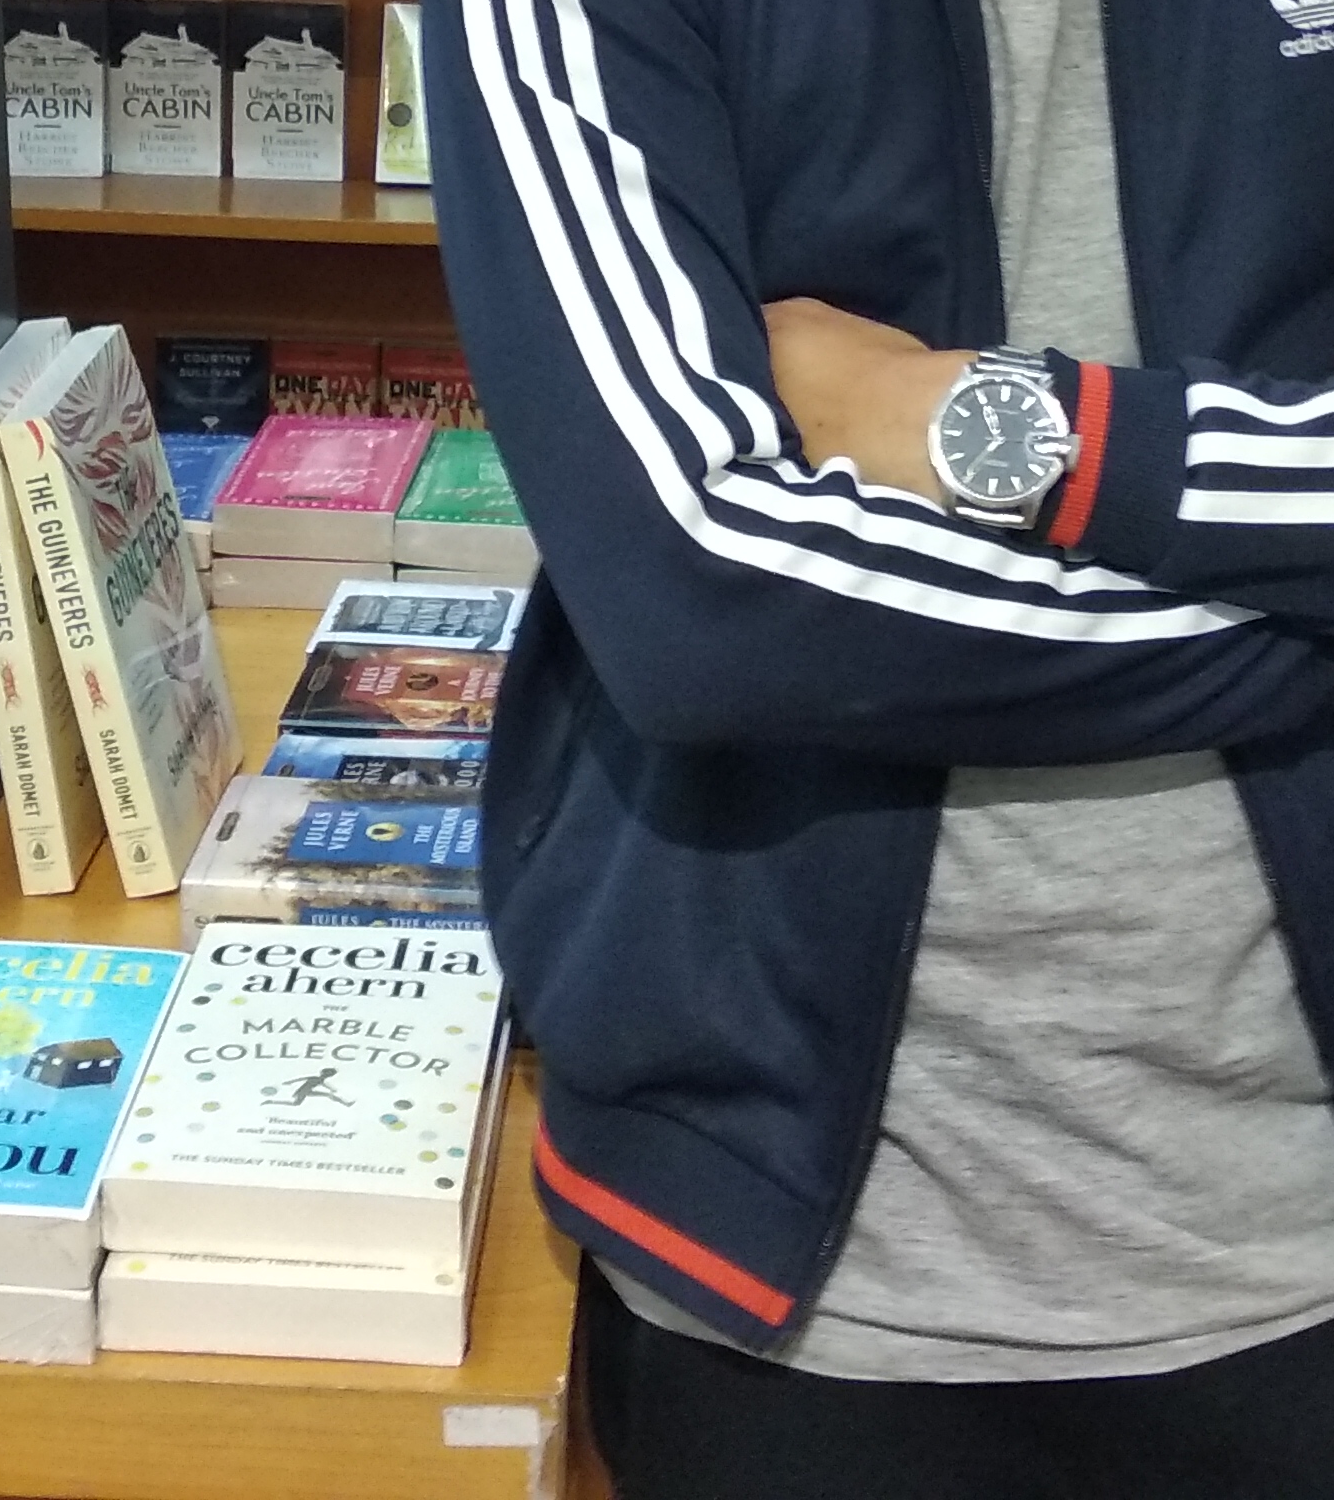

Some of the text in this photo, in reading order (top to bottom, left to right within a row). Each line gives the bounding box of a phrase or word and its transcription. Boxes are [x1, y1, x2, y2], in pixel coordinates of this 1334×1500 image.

[51, 82, 93, 98] Tom's
[124, 81, 212, 99] Uncle Tom's
[247, 85, 335, 102] Uncle Tom's
[122, 98, 213, 121] CABIN
[245, 100, 335, 125] CABIN
[274, 375, 324, 394] ONE
[389, 379, 436, 399] ONE
[25, 472, 139, 821] THE GUINEVERES SARAH DOMET
[355, 665, 381, 692] JULES
[375, 664, 404, 696] VERNE
[9, 725, 36, 769] SARAH
[18, 772, 42, 818] DOMET
[303, 810, 334, 848] JULES
[327, 810, 361, 852] VERNE
[413, 823, 436, 845] THE
[428, 805, 463, 866] MYSTERIOUS
[454, 817, 479, 855] ISLAND
[209, 936, 489, 978] cecelia
[240, 966, 427, 1000] ahern
[241, 1017, 415, 1043] MARBLE
[183, 1041, 452, 1078] COLLECTOR
[172, 1153, 406, 1176] THE SUNDAY TIMES BESTSELLER
